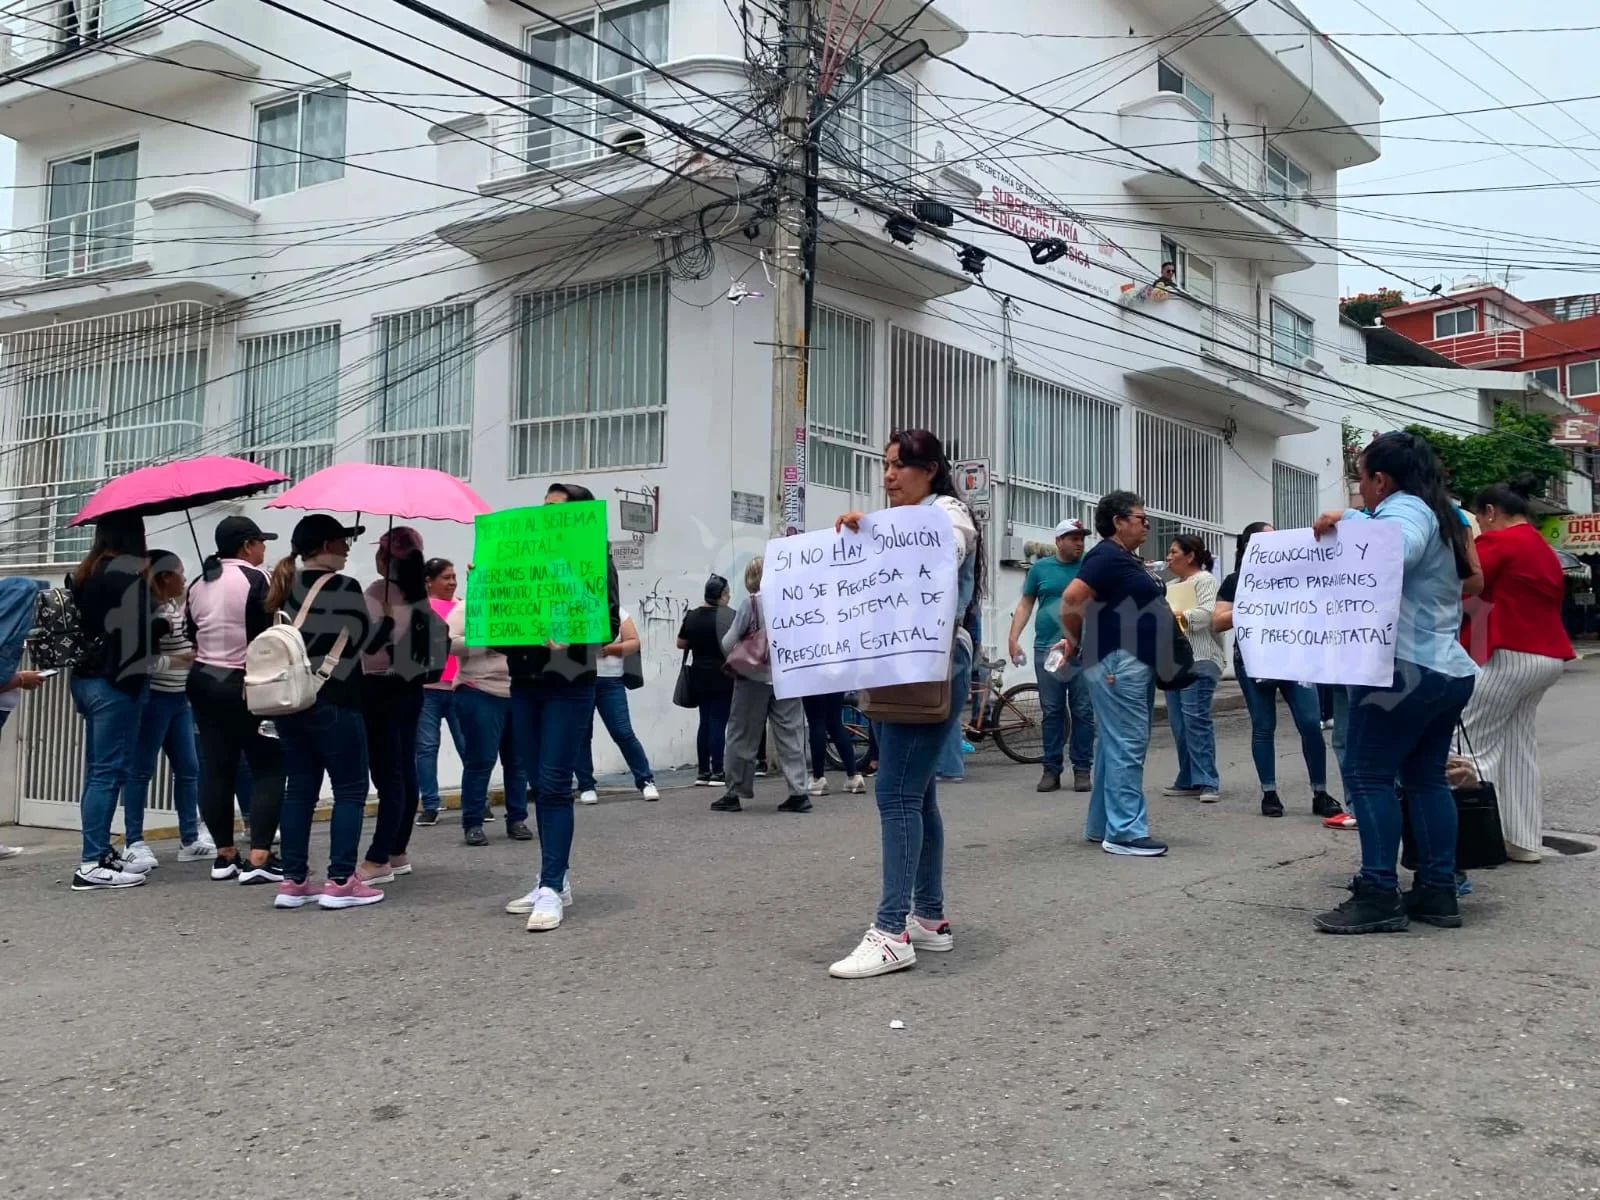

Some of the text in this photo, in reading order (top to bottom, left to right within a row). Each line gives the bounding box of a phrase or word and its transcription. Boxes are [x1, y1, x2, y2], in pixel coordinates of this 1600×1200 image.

[974, 199, 990, 220] DE
[992, 185, 1079, 243] SUBSECRETARÍA
[775, 551, 792, 571] SI
[801, 547, 823, 564] NO
[1355, 542, 1369, 561] Y
[529, 562, 548, 582] UNA
[580, 559, 594, 576] DE
[782, 586, 803, 601] NO
[809, 583, 829, 597] SE
[919, 564, 932, 580] A
[837, 592, 909, 623] SISTEMA
[921, 591, 945, 605] DE
[1237, 600, 1318, 616] SOSTUVIMOS
[532, 618, 547, 637] SE
[1237, 626, 1254, 641] DE
